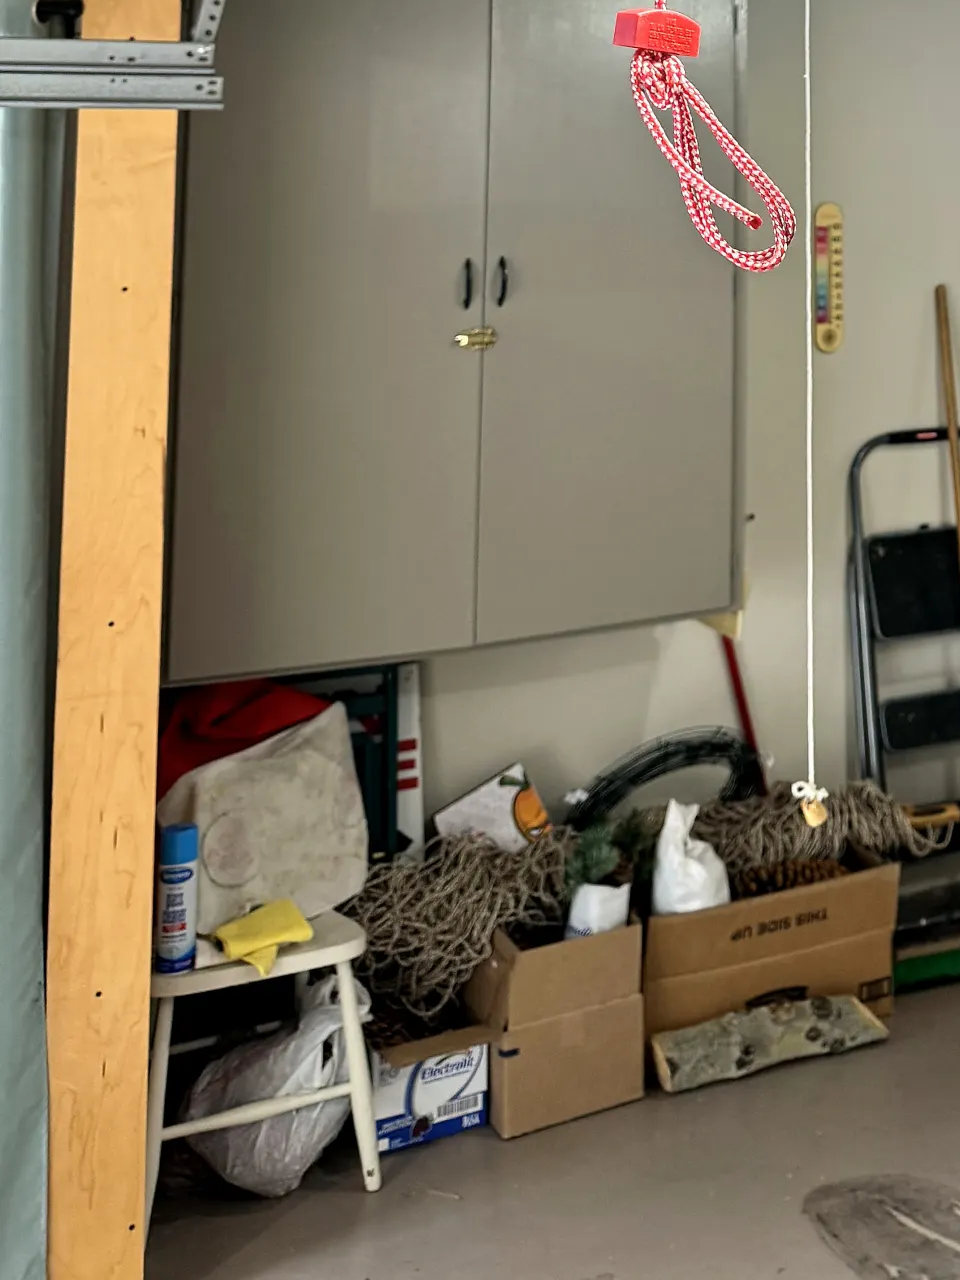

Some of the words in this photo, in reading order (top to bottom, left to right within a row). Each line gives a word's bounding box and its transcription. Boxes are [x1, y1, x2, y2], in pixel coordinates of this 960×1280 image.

[756, 915, 792, 937] SIDE
[794, 907, 829, 928] THIS
[729, 926, 754, 943] UP
